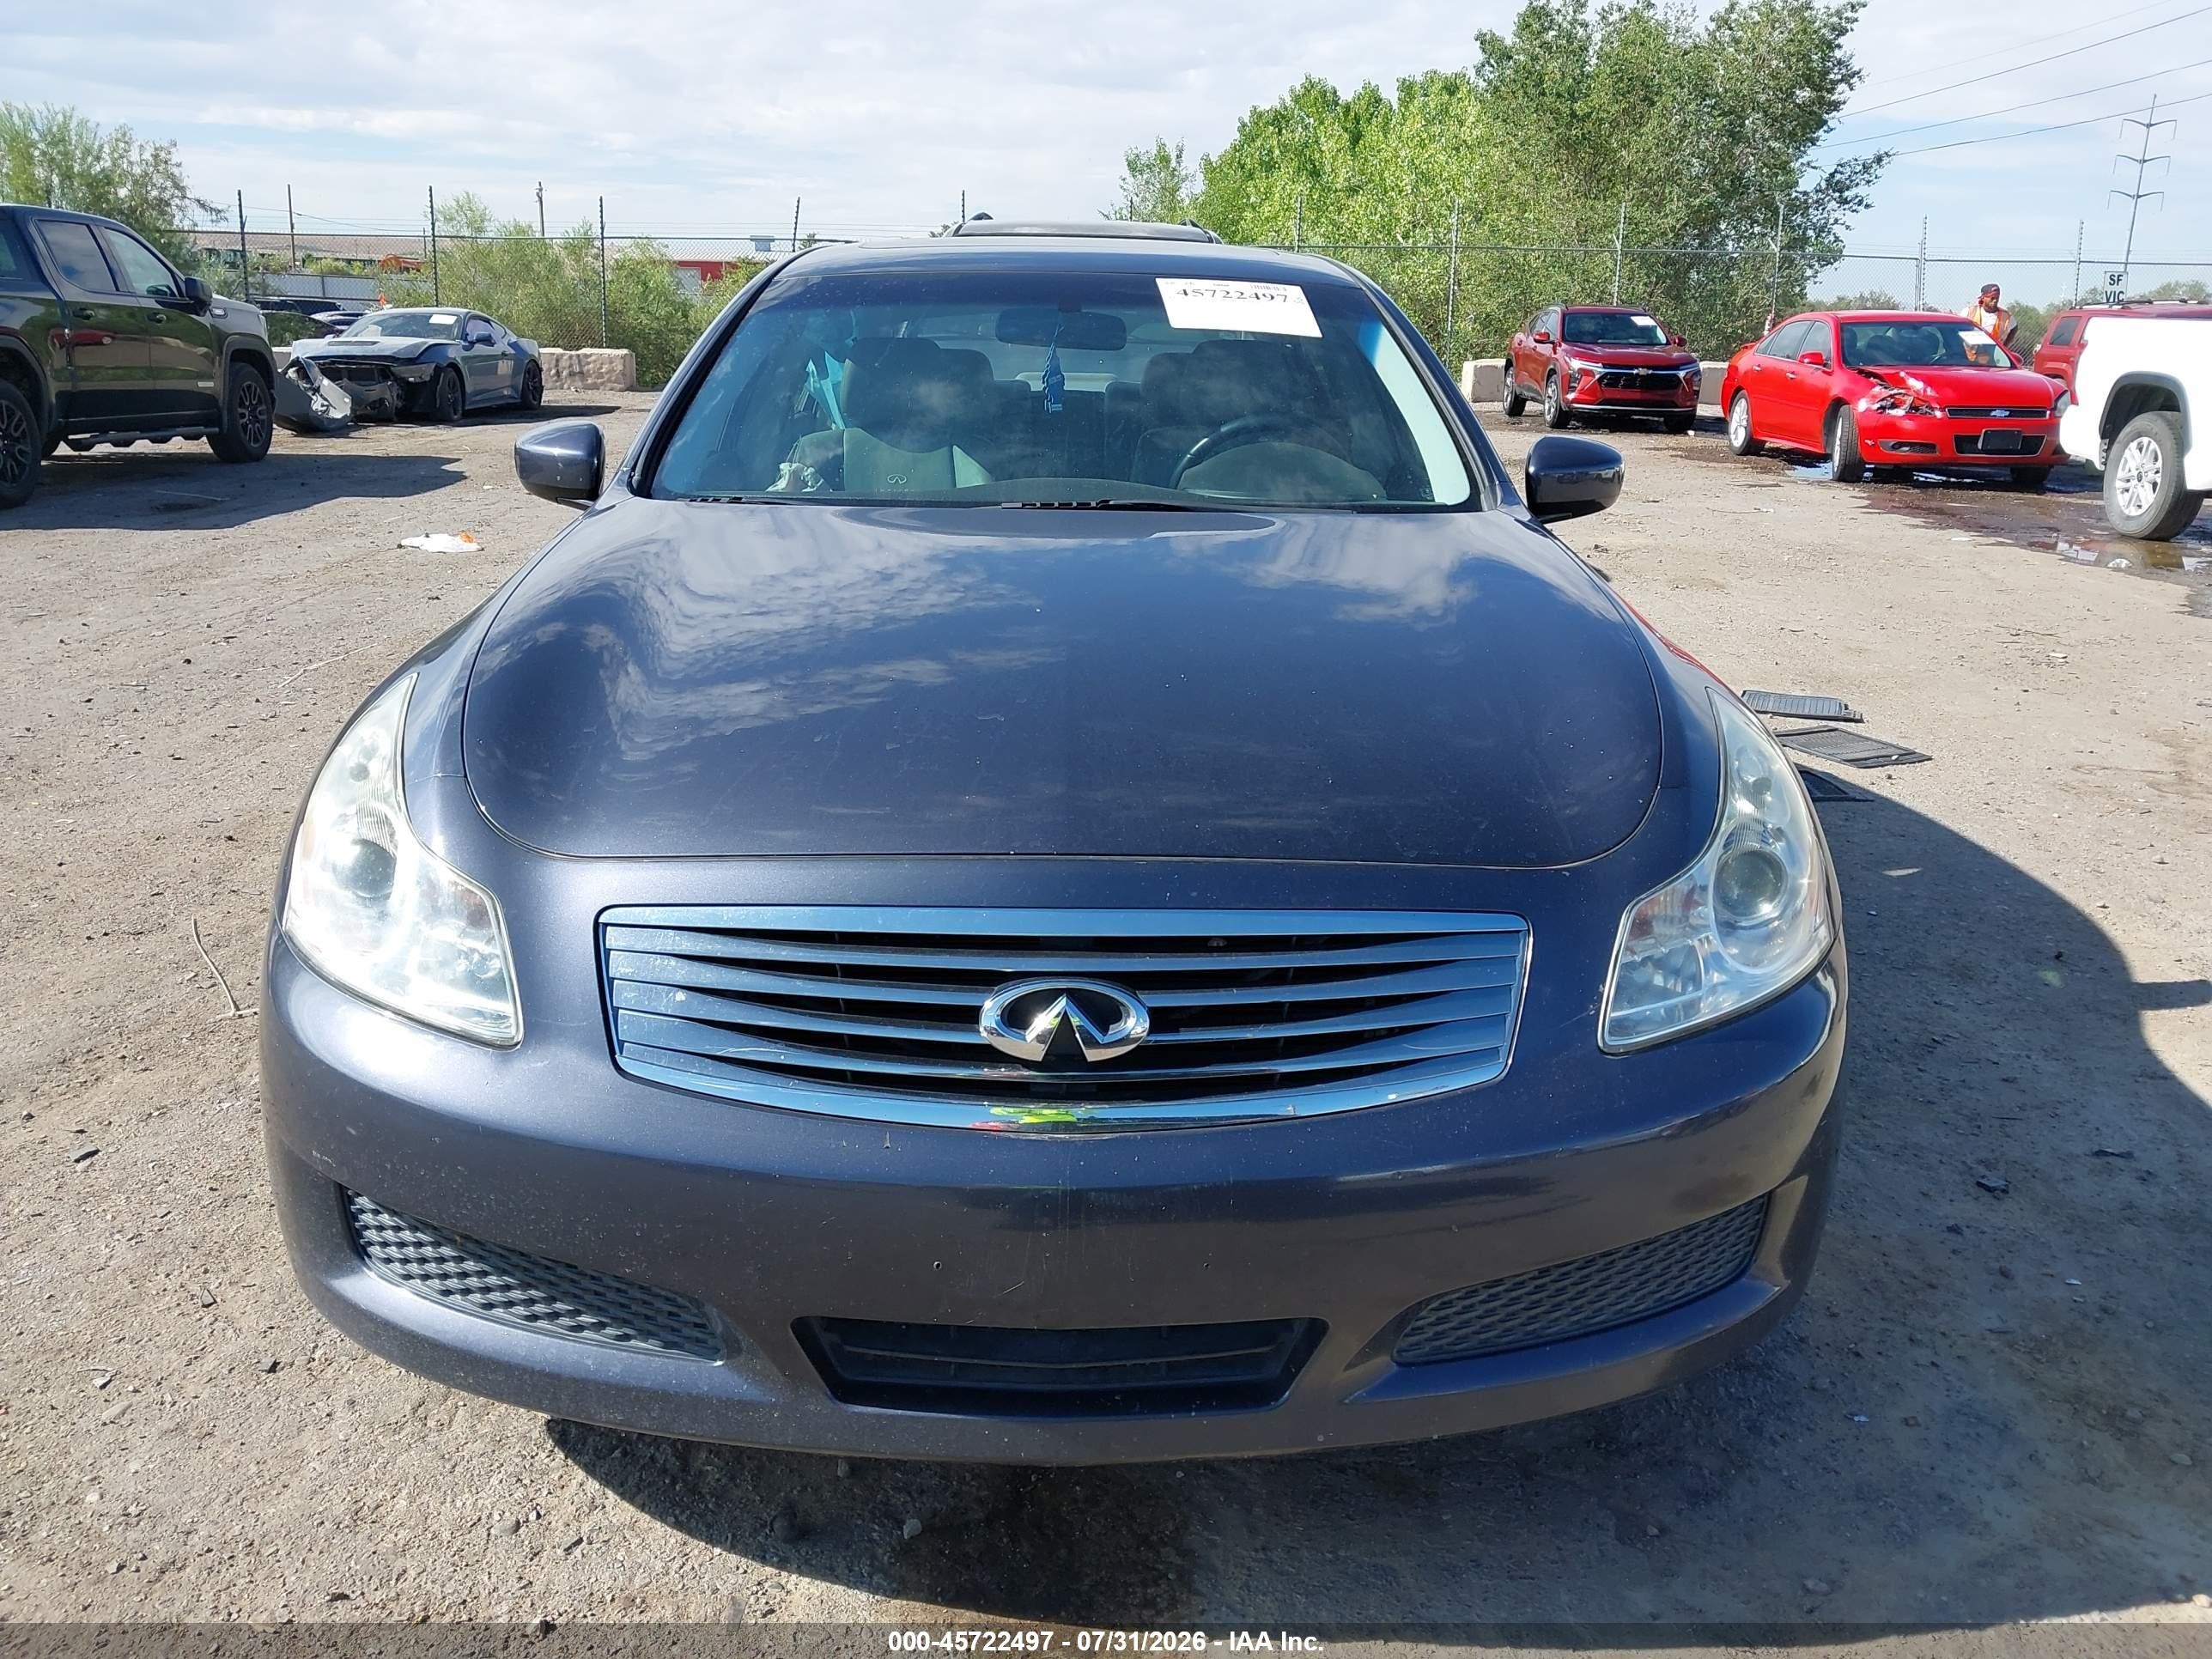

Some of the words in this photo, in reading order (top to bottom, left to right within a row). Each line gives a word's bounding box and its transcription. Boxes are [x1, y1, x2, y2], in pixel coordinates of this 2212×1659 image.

[2108, 274, 2124, 286] SF
[1176, 289, 1288, 303] 45722497
[2105, 290, 2124, 303] VIC
